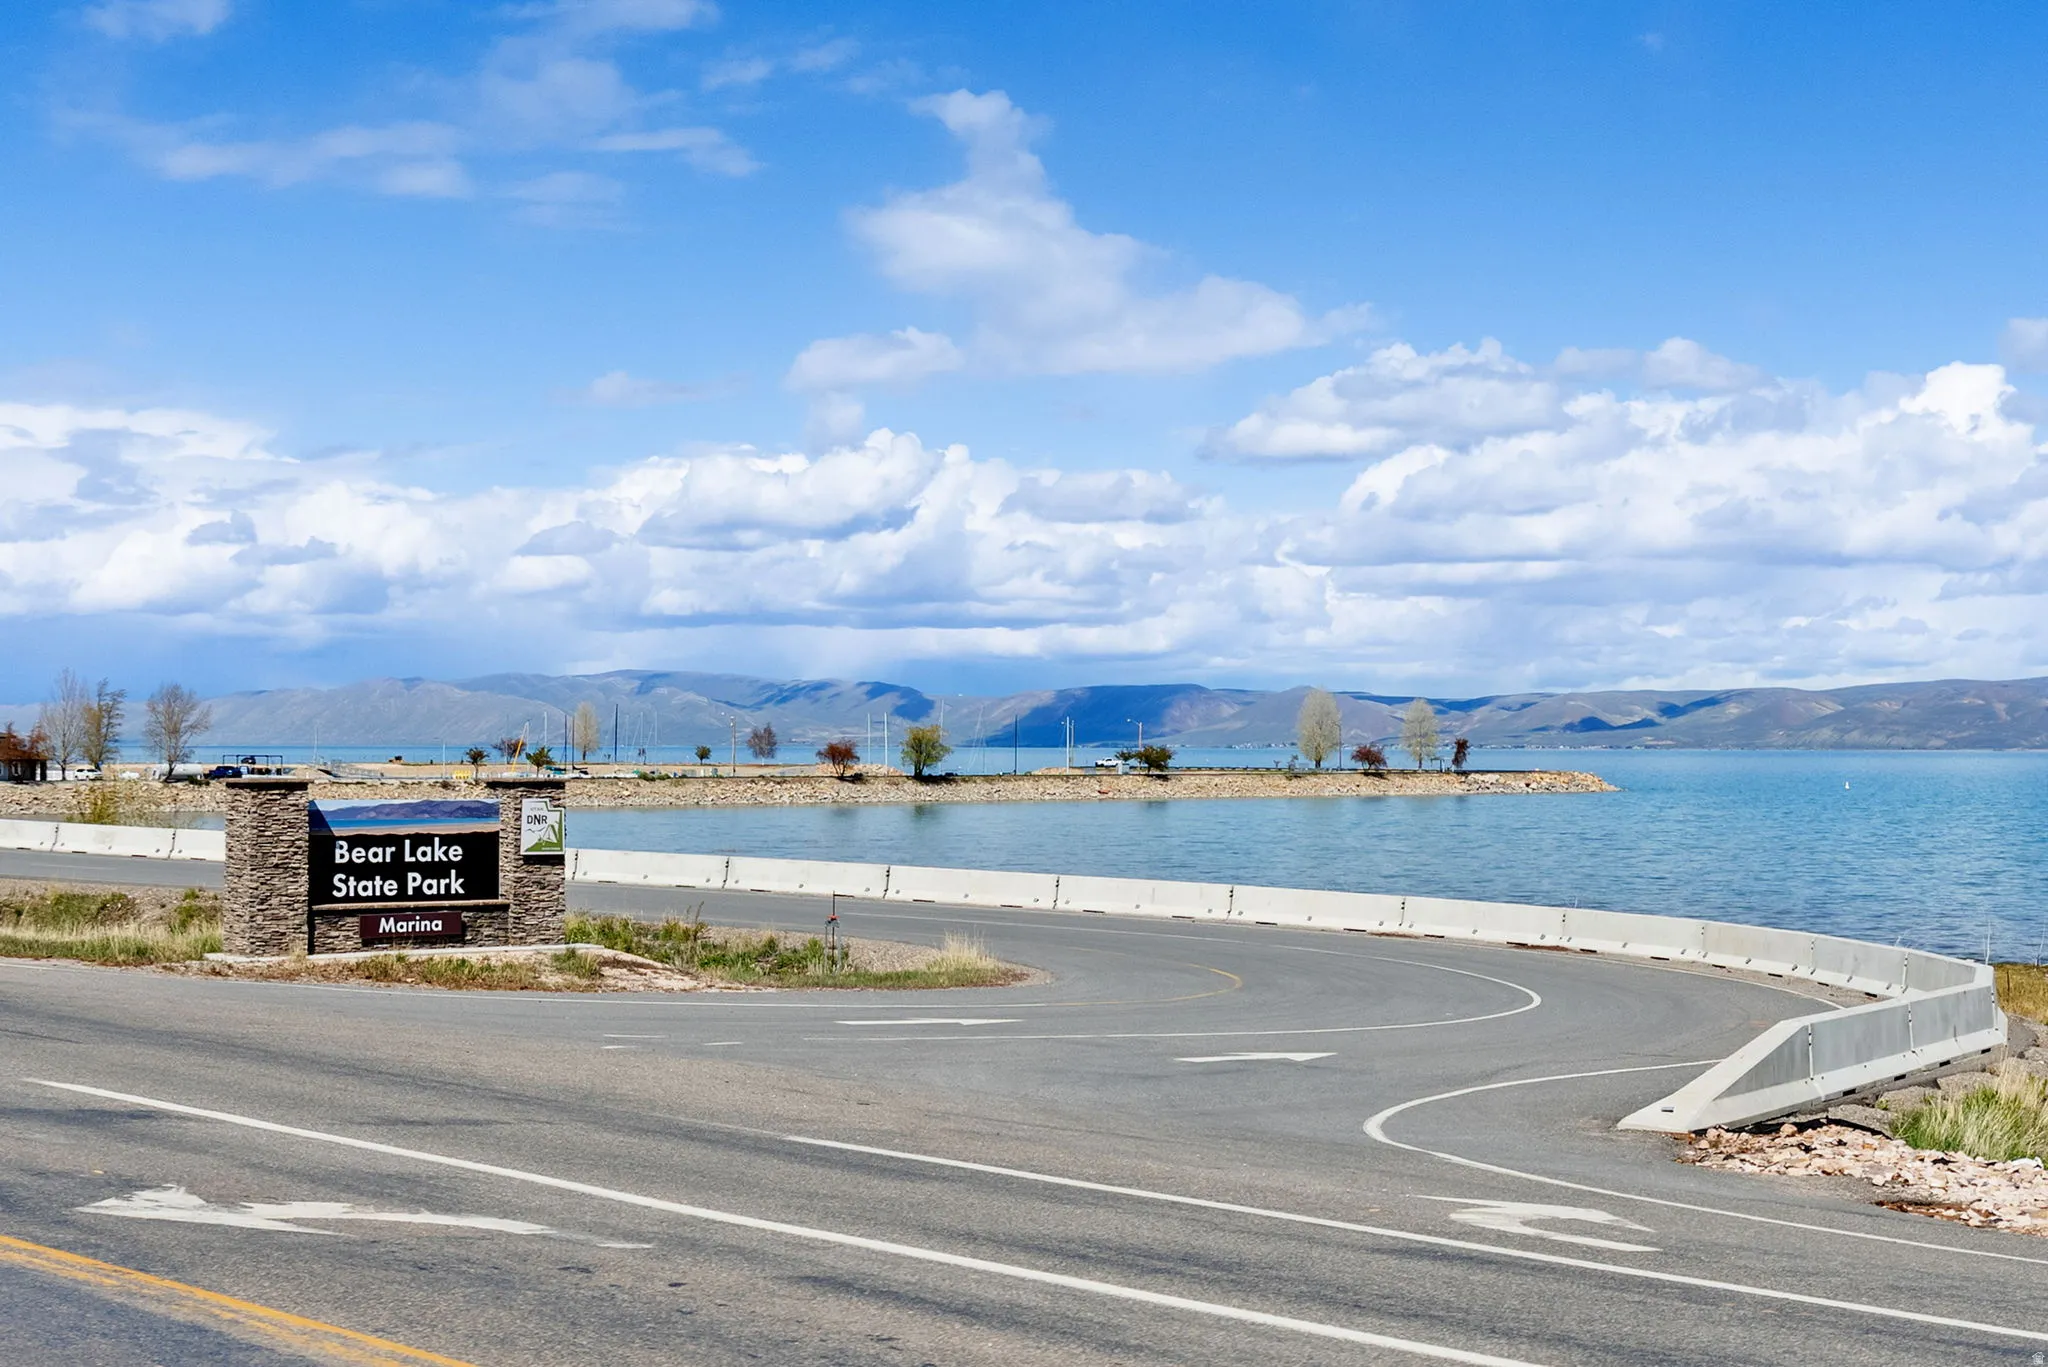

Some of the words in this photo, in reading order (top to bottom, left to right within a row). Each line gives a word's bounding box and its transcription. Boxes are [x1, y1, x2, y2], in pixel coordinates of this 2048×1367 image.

[527, 814, 547, 825] DNR
[334, 839, 396, 864] Bear
[404, 837, 463, 863] Lake
[332, 873, 398, 898] State
[407, 869, 465, 895] Park
[378, 913, 443, 934] Marina
